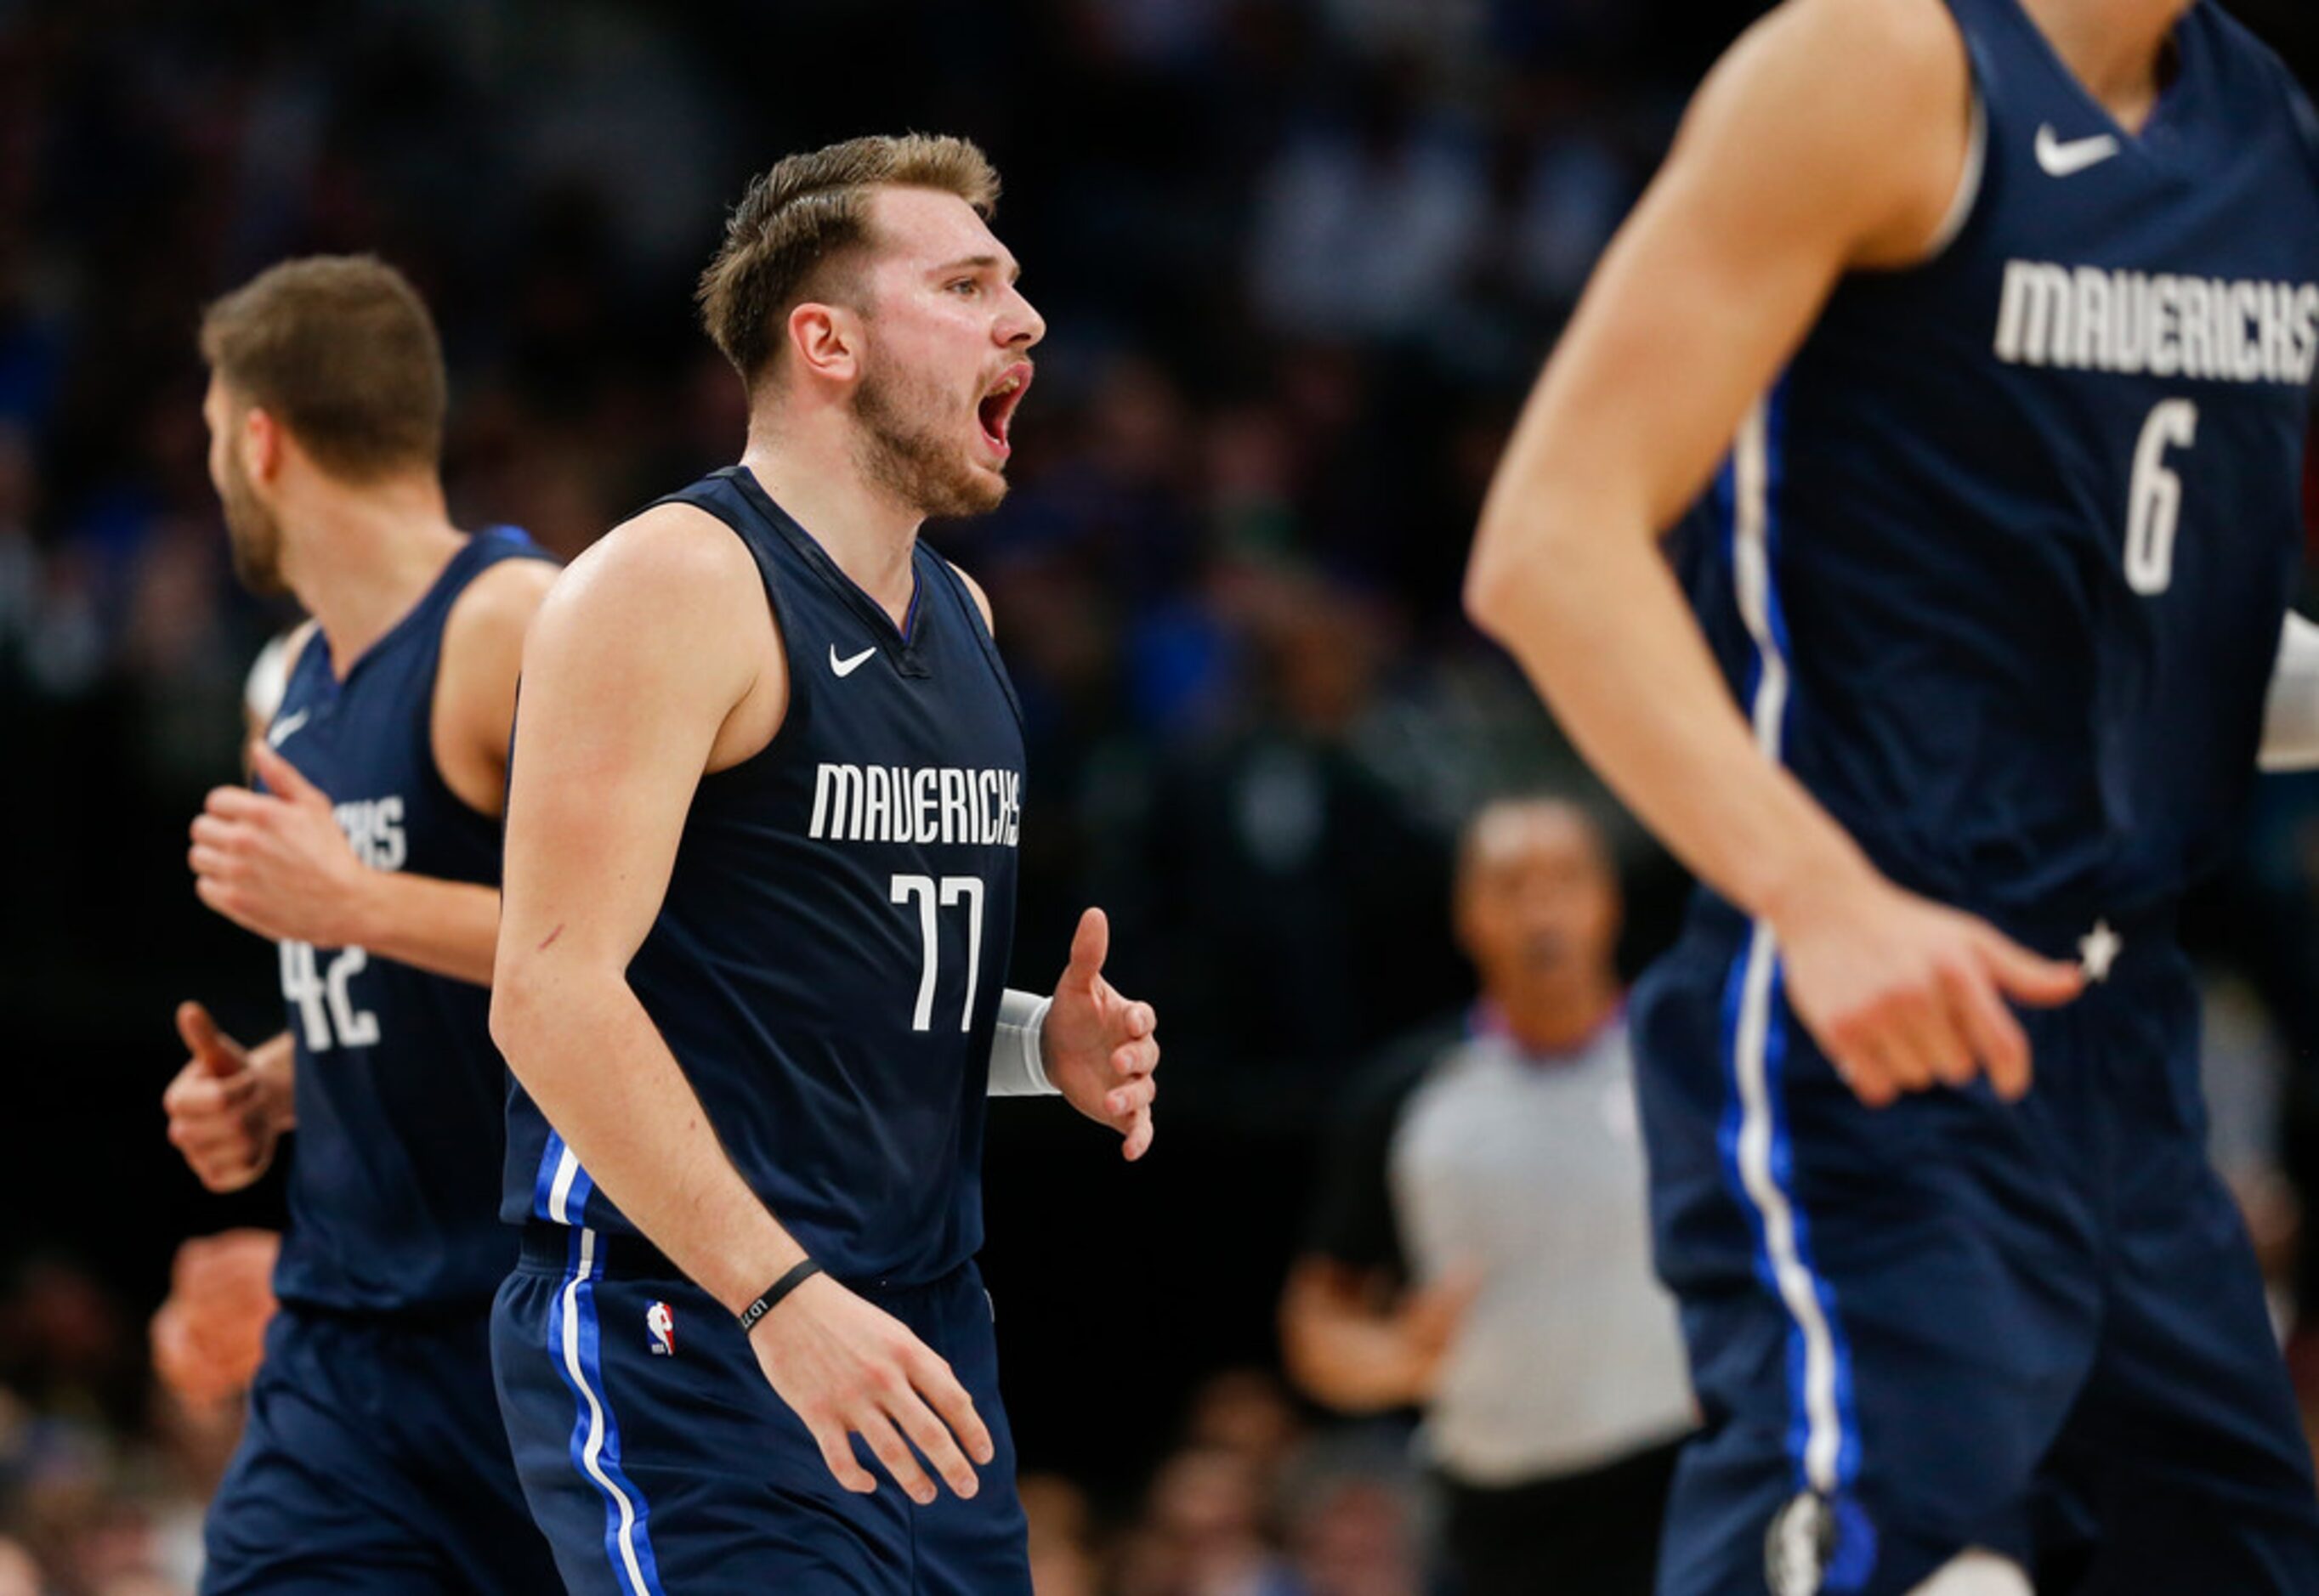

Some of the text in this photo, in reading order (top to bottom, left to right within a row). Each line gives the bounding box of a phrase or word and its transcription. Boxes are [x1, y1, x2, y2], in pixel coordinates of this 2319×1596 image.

[1993, 258, 2319, 385] MAVERICKS
[2123, 397, 2198, 597] 6
[808, 763, 1019, 847] MAVERICKS
[278, 937, 380, 1051] 42
[890, 874, 984, 1033] 77
